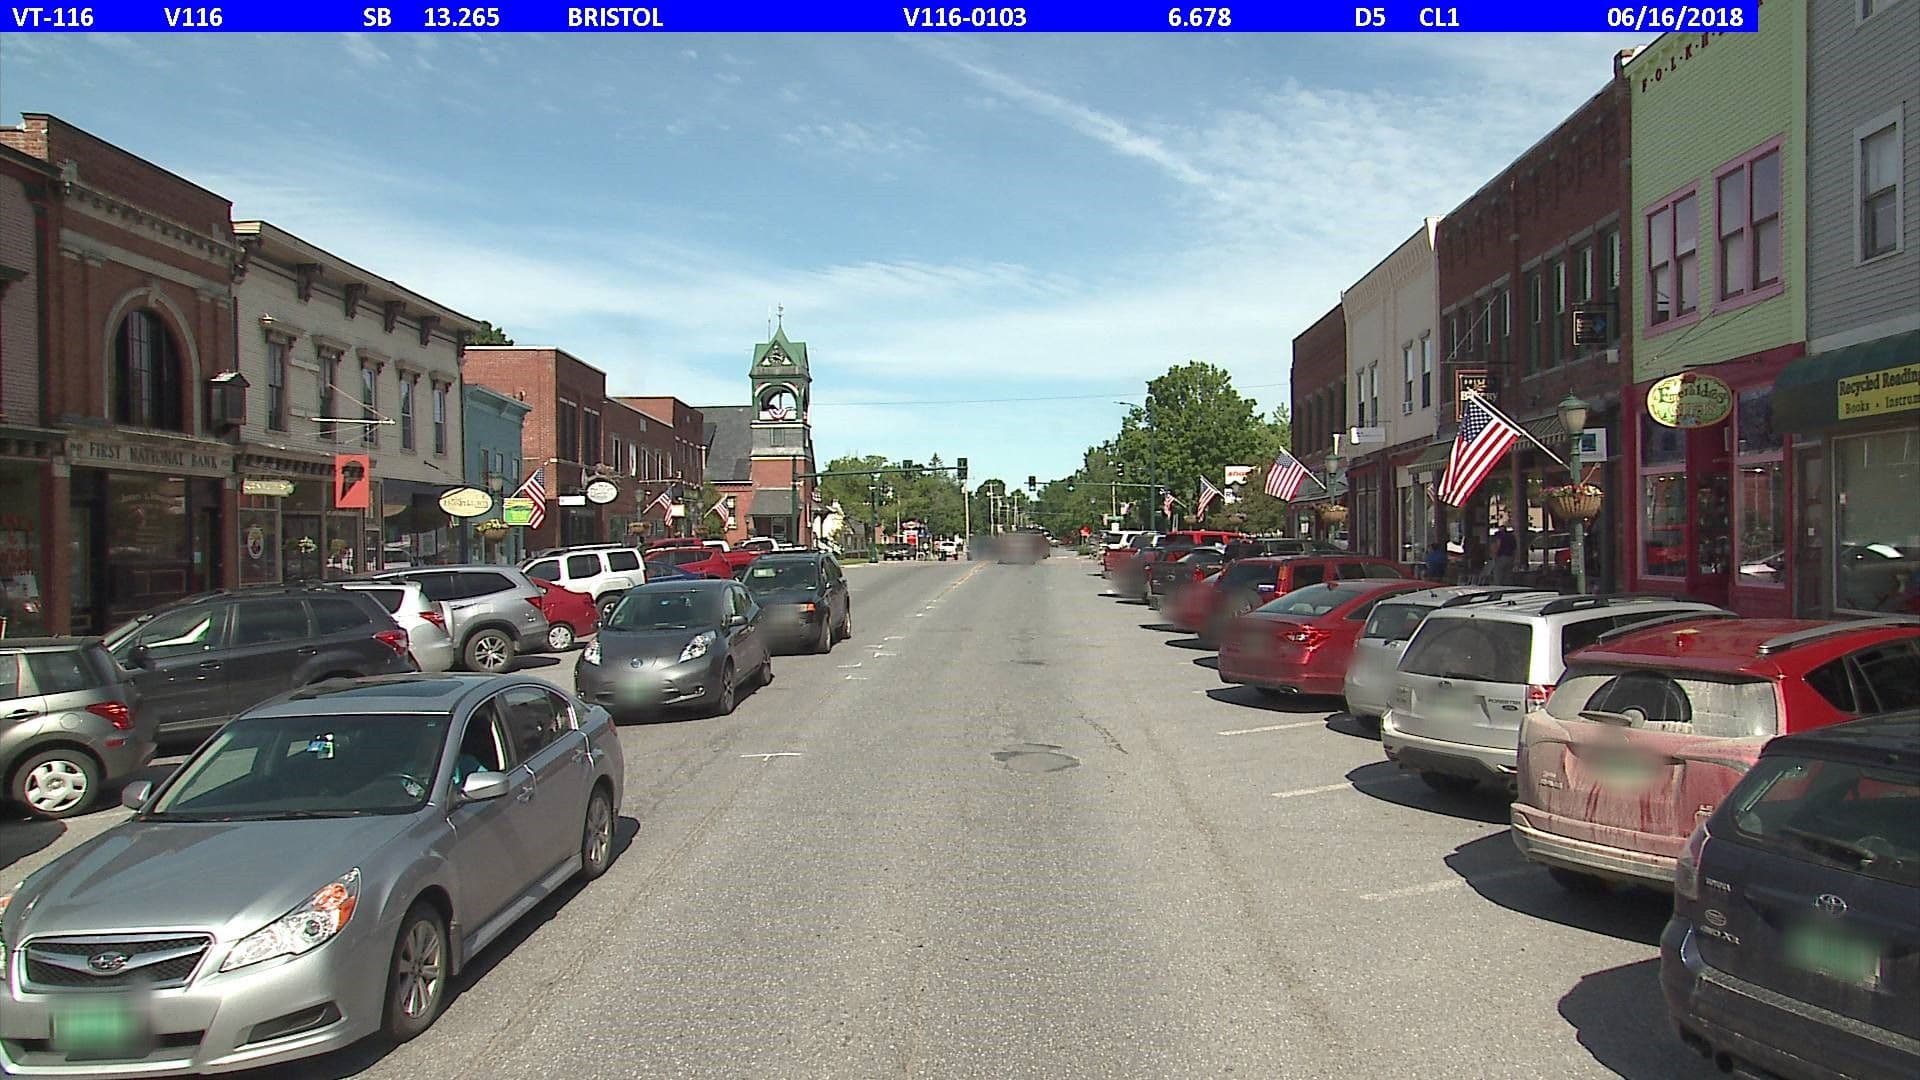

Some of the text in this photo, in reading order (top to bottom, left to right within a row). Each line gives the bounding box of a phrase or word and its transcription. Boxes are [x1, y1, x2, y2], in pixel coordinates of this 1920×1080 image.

[1840, 374, 1880, 397] Recycled
[1461, 391, 1498, 402] BAERY
[1845, 401, 1870, 415] Books
[90, 442, 217, 469] FIRST NATIONAL BANK
